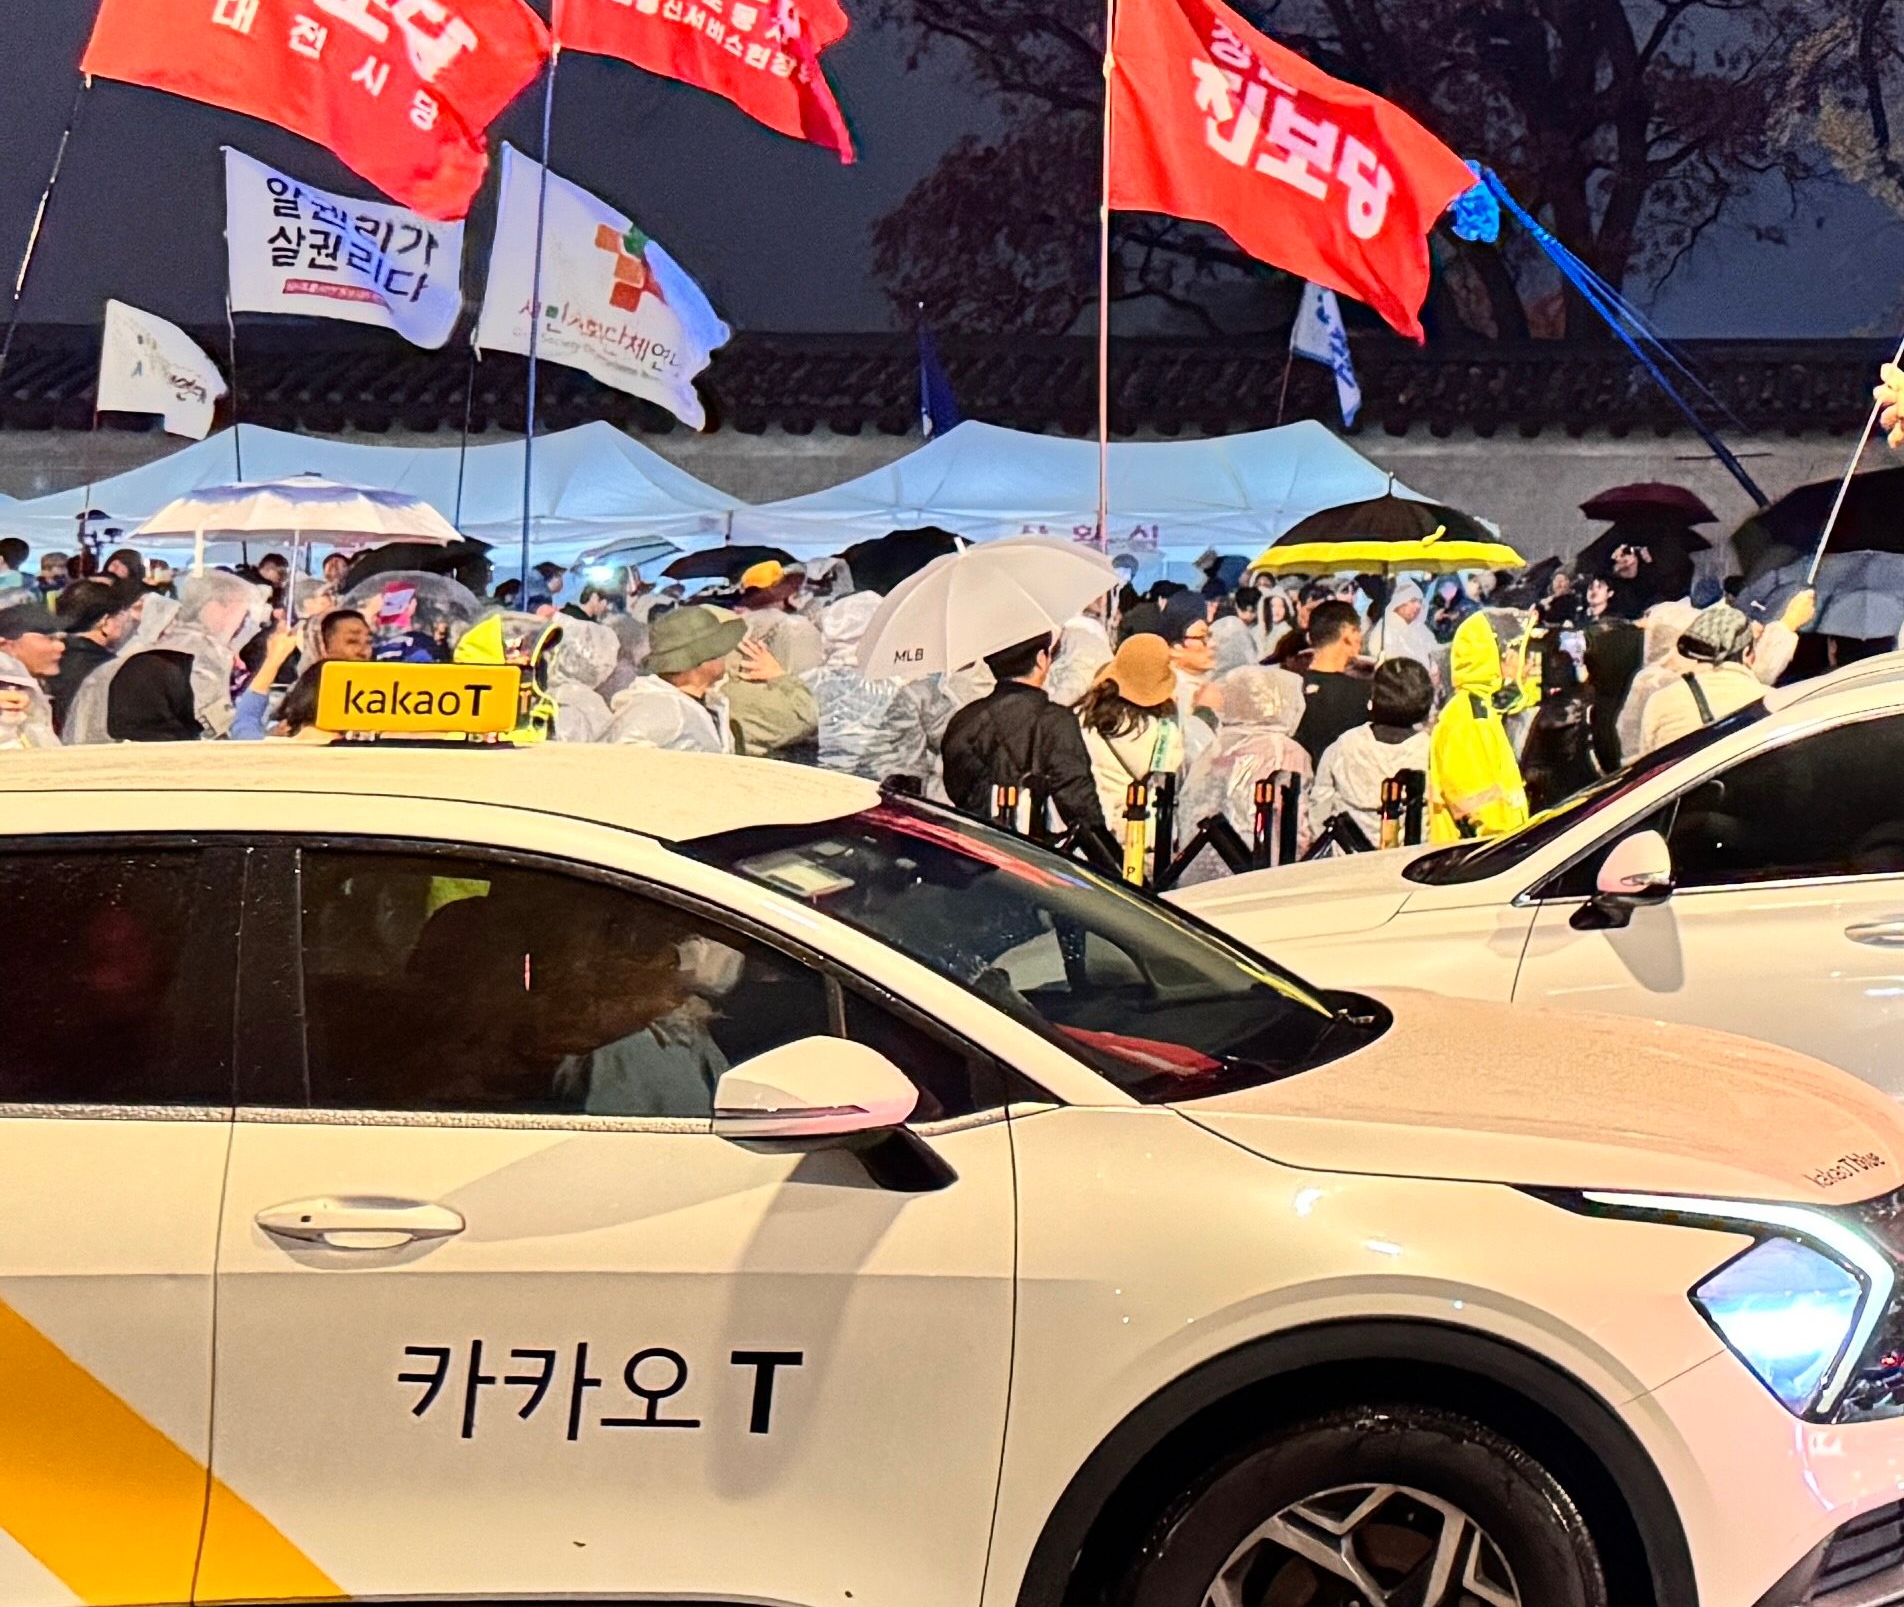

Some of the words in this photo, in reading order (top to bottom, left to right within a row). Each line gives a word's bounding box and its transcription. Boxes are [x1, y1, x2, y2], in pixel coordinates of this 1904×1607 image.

[1191, 57, 1395, 241] 진보당
[893, 647, 925, 665] MLB
[397, 1339, 701, 1442] 카카오
[729, 1350, 804, 1435] T
